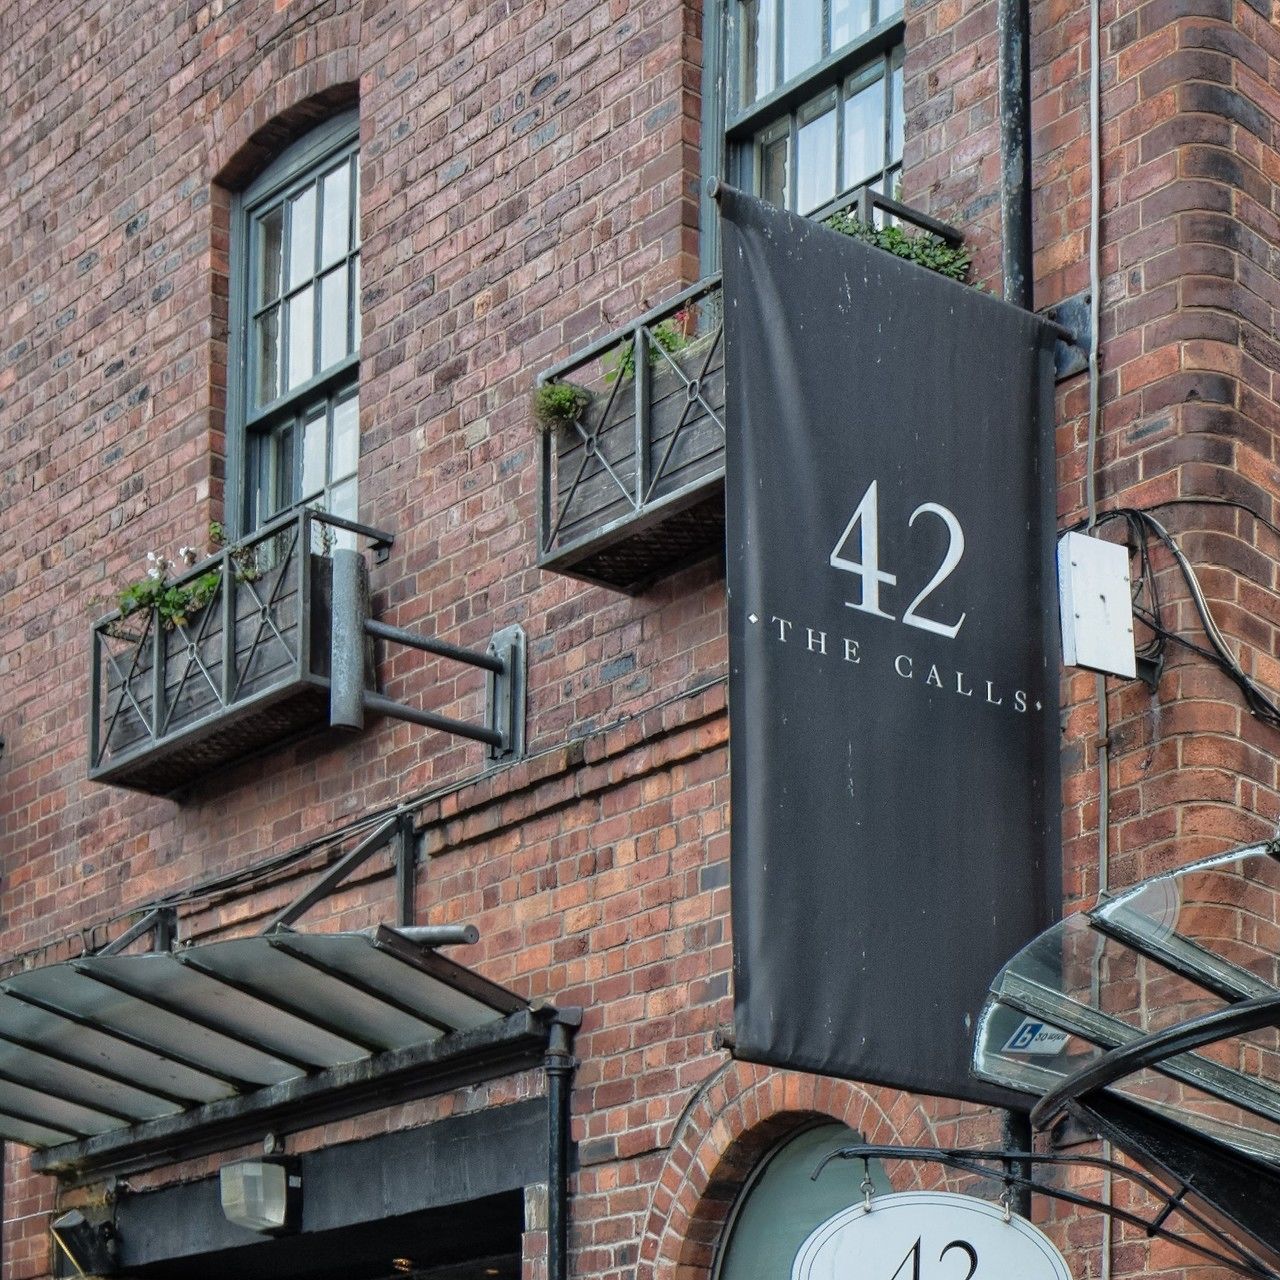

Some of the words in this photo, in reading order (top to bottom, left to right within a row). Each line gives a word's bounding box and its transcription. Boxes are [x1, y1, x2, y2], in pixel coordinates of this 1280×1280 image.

[829, 479, 966, 640] 42
[771, 615, 862, 664] THE
[894, 654, 1027, 713] CALLS
